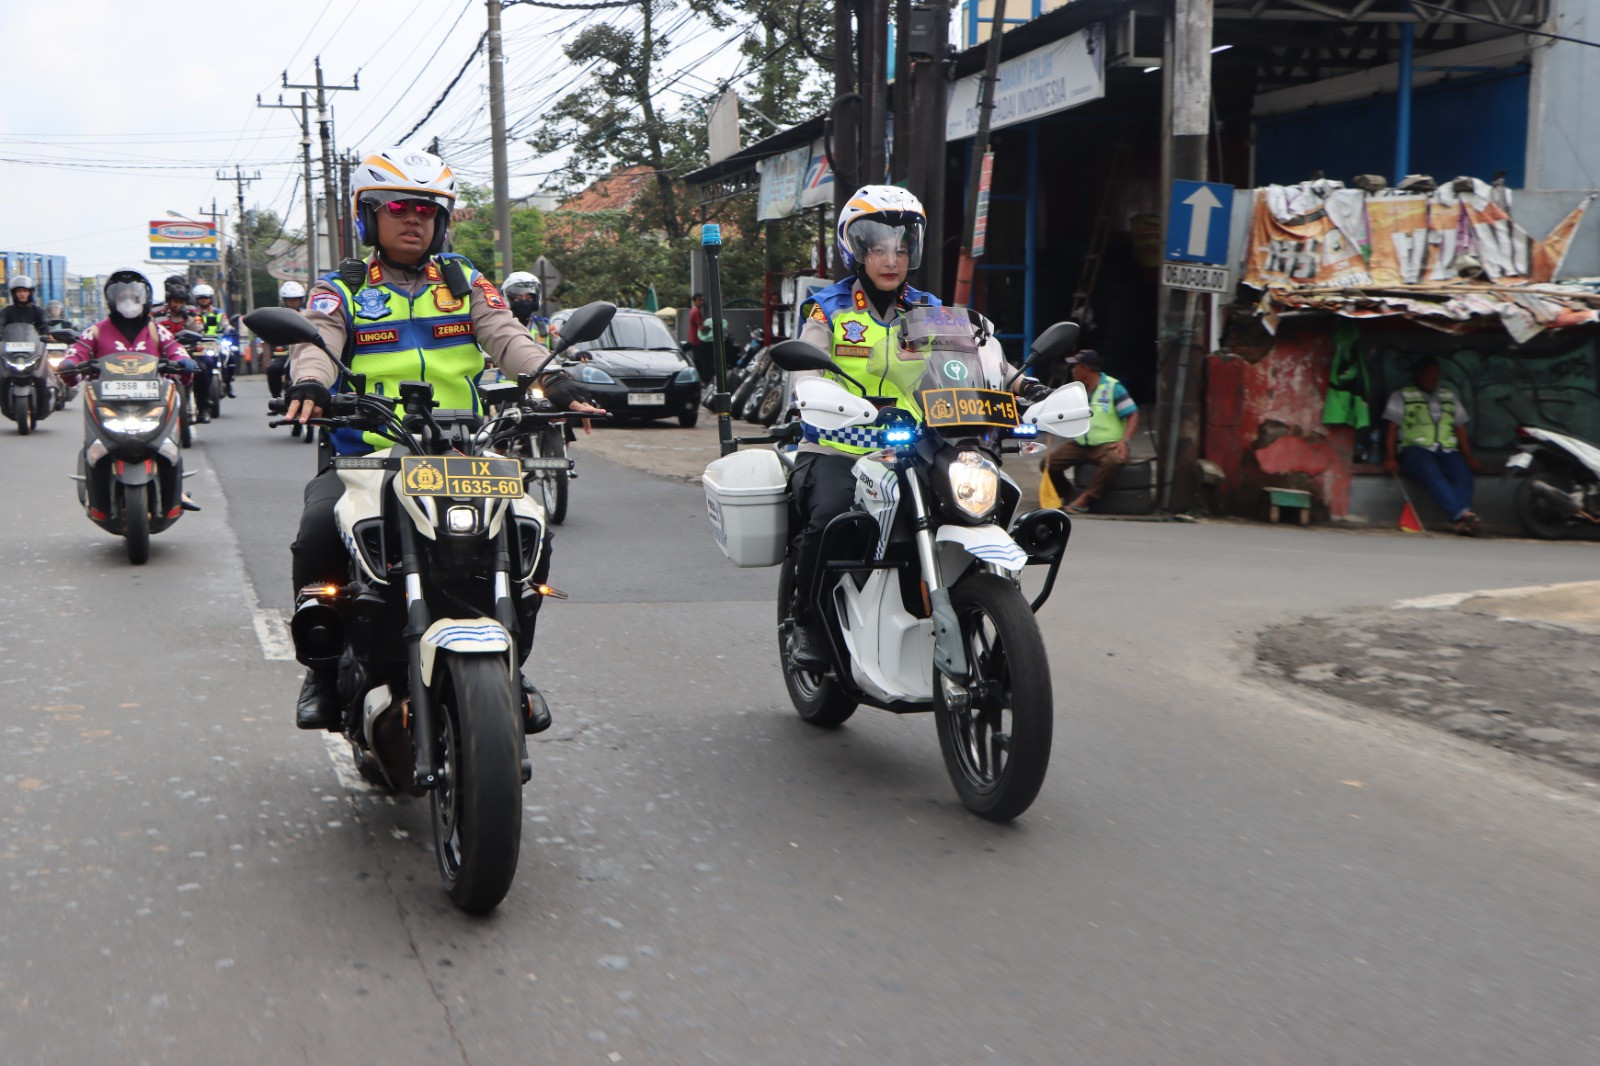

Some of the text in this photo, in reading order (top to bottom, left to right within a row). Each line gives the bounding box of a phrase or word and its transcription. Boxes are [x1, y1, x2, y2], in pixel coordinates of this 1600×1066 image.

[1018, 77, 1067, 115] INDONESIA
[359, 331, 395, 342] LINGGA
[437, 324, 465, 335] ZEBRA
[959, 398, 1015, 419] 9021-15
[471, 461, 492, 476] IX
[451, 479, 519, 495] 1635-60
[860, 472, 873, 488] ZERO
